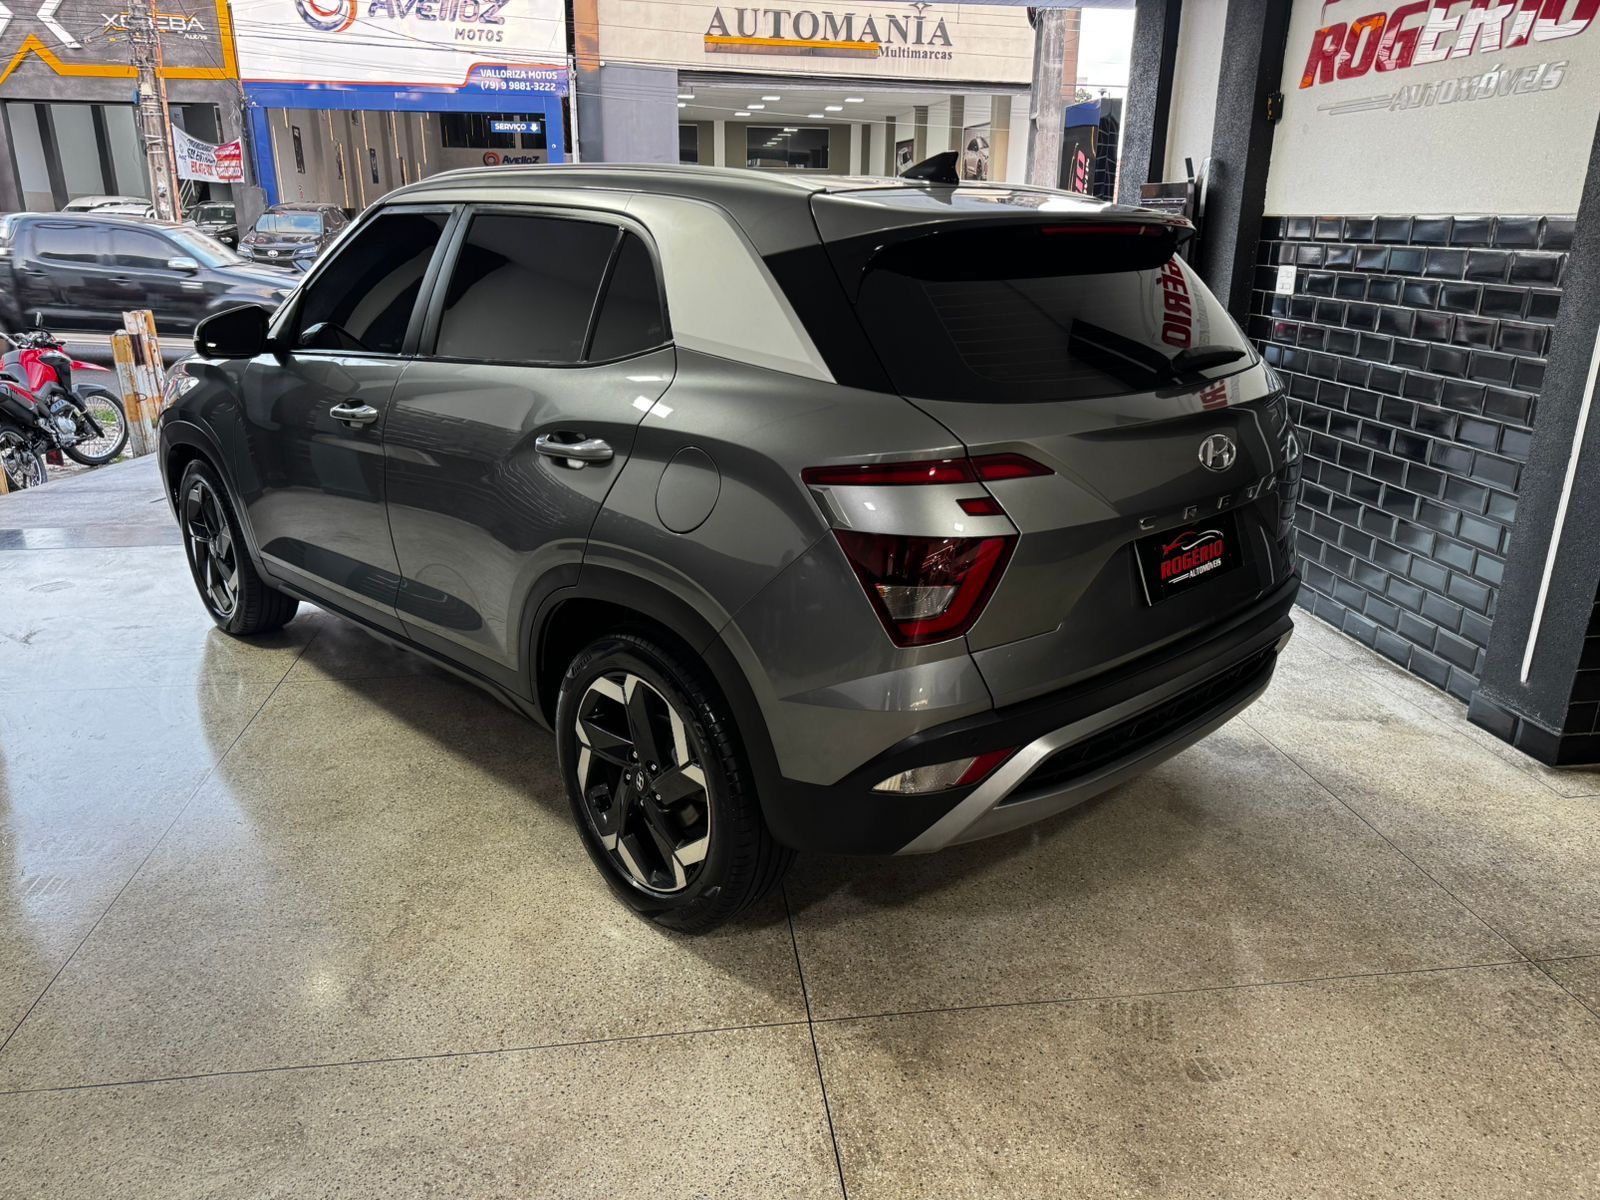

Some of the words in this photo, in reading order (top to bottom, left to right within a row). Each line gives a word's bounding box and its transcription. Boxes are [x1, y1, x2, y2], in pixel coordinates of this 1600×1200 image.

[455, 28, 503, 42] MOTOS
[878, 45, 953, 60] Multimarcas
[480, 69, 526, 78] VALLORIZA
[528, 71, 558, 80] MOTOS
[481, 81, 498, 91] (79)
[501, 82, 507, 90] 9
[509, 82, 556, 91] 9881-3222
[1390, 60, 1570, 112] AUTOMÓVEIS
[494, 123, 527, 132] SERVIÇO
